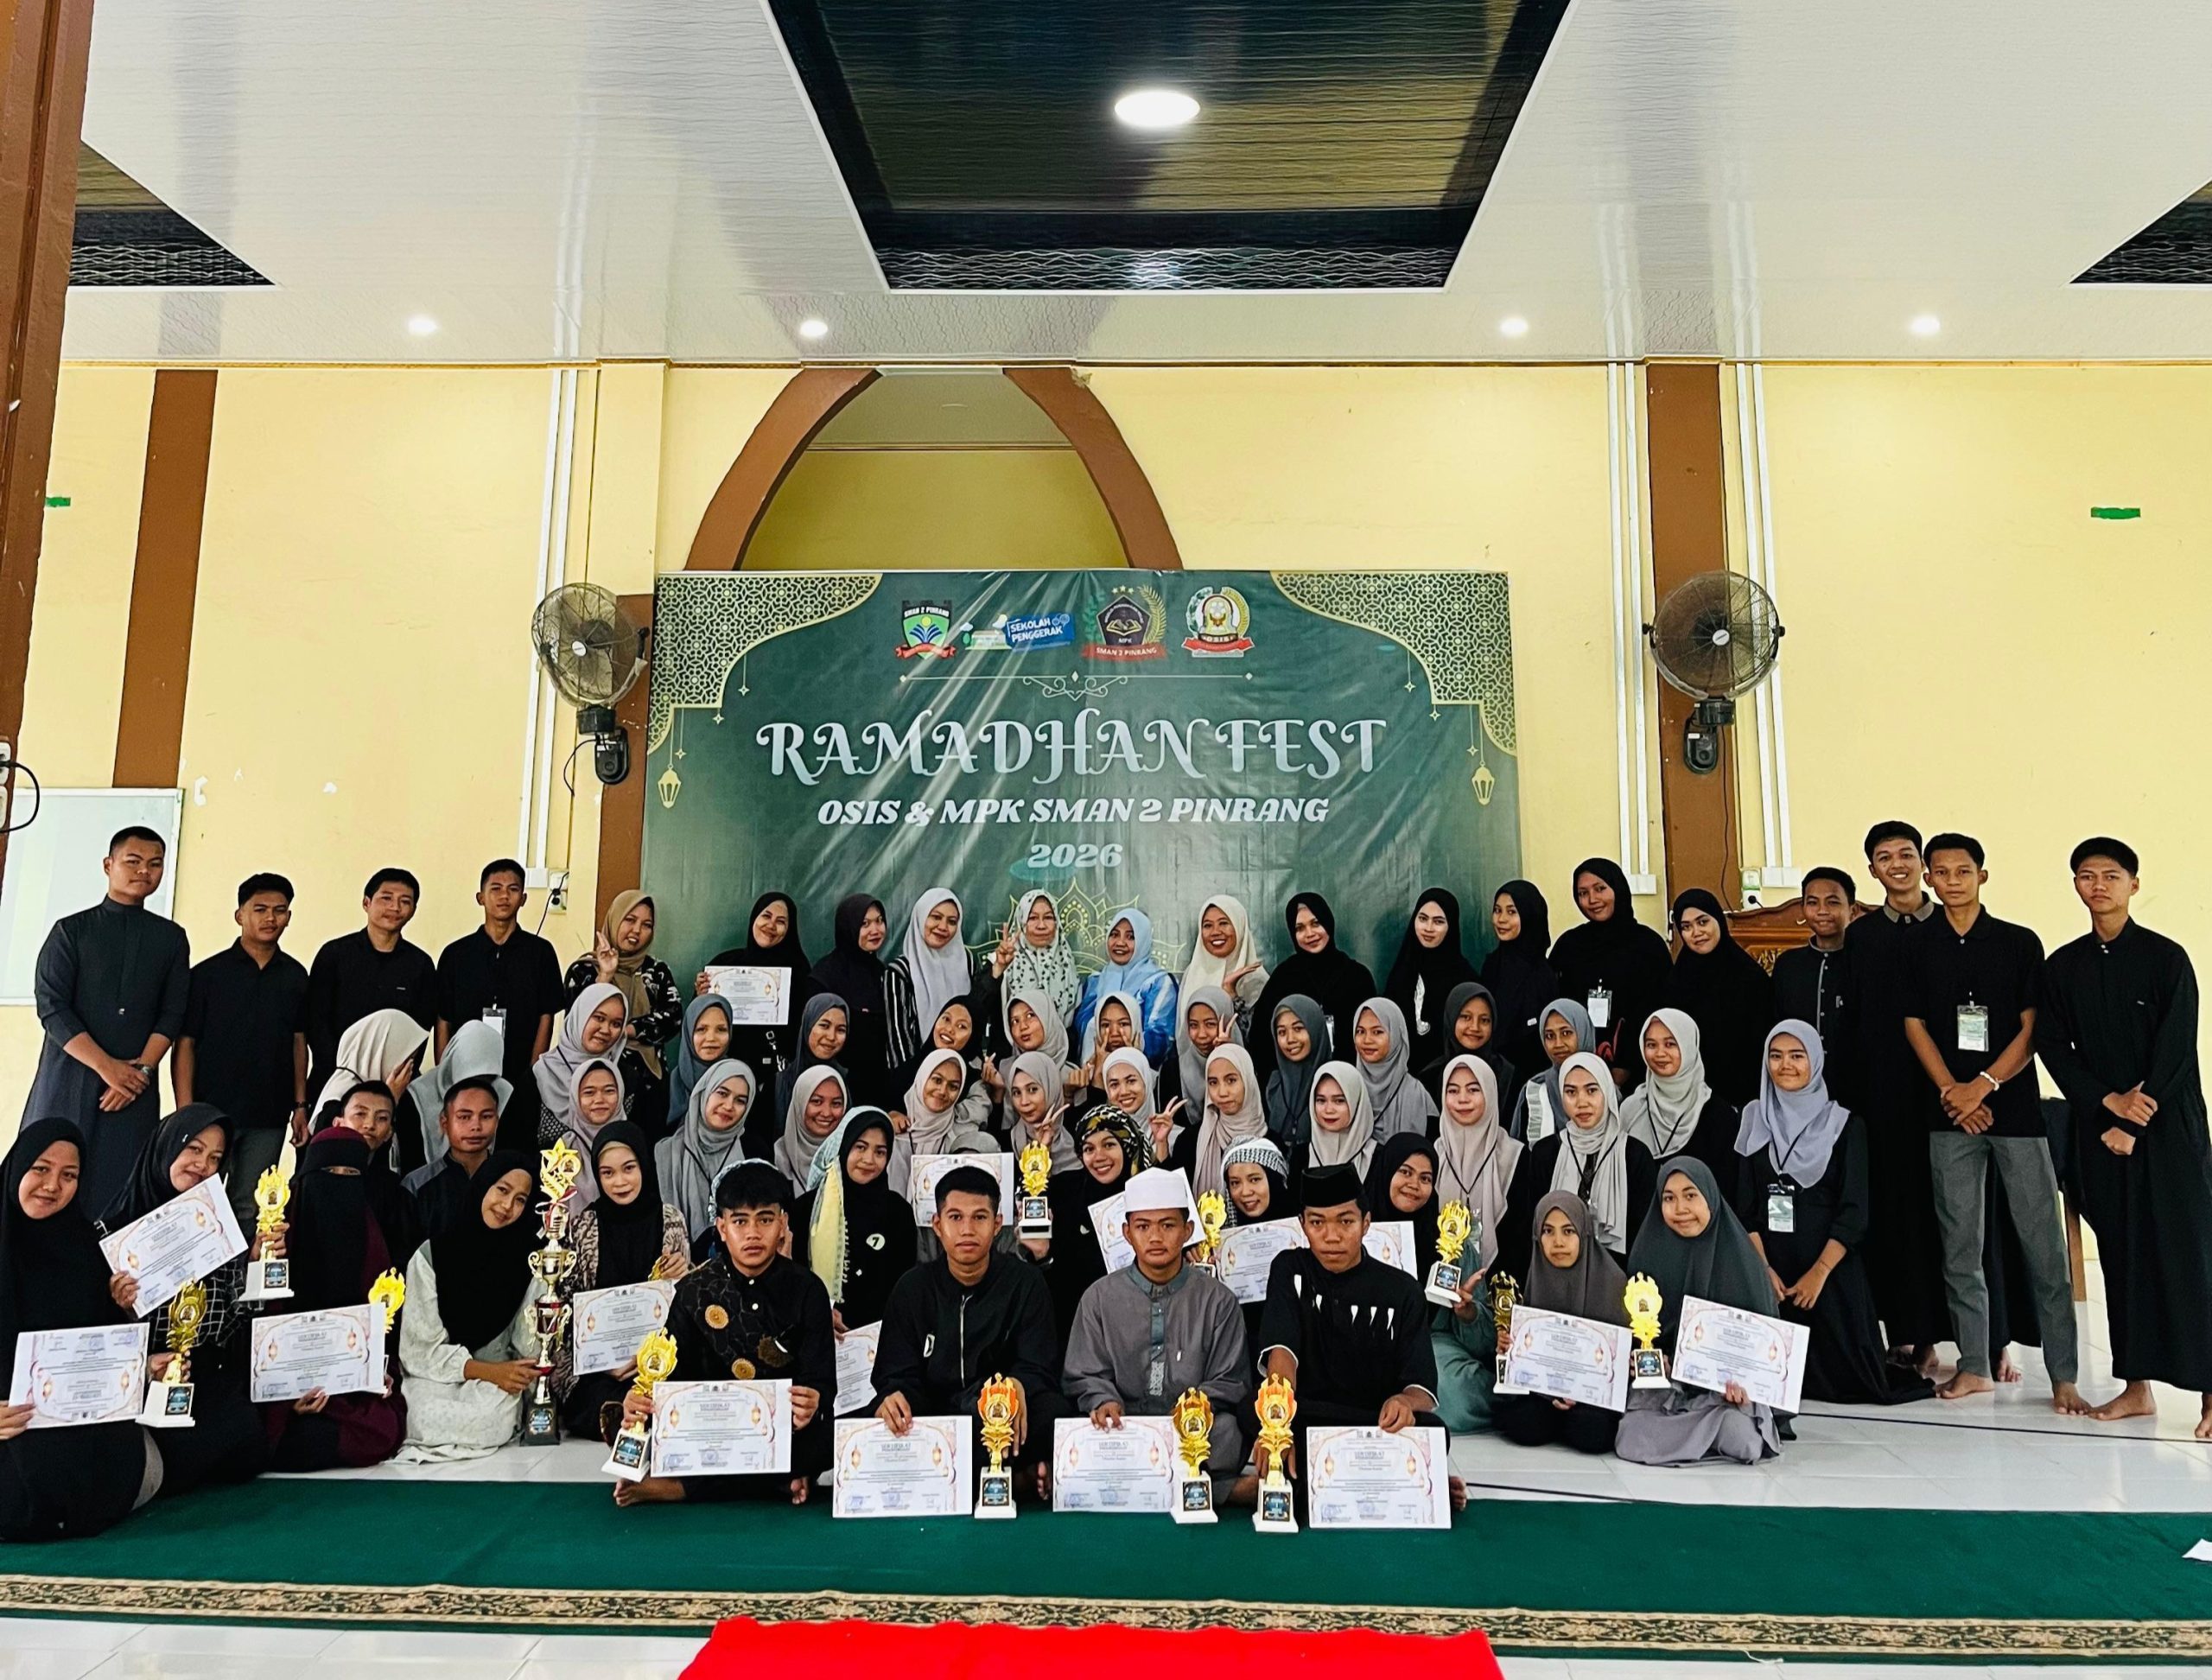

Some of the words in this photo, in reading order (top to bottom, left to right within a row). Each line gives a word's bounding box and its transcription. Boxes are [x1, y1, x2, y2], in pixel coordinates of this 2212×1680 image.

[1010, 618, 1051, 633] SEKOLAH
[1011, 626, 1064, 643] PENGGERAK
[1096, 647, 1117, 656] SMAN
[1124, 647, 1157, 656] PINRANG
[756, 709, 1210, 786] RAMADHAN
[1215, 719, 1387, 780] FEST
[817, 799, 901, 824] OSIS
[905, 800, 935, 827] &
[938, 799, 1025, 824] MPK
[1028, 798, 1135, 823] SMAN
[1138, 799, 1163, 822] 2
[1166, 797, 1330, 822] PINRANG
[1027, 843, 1123, 869] 2026
[872, 1237, 880, 1247] 7
